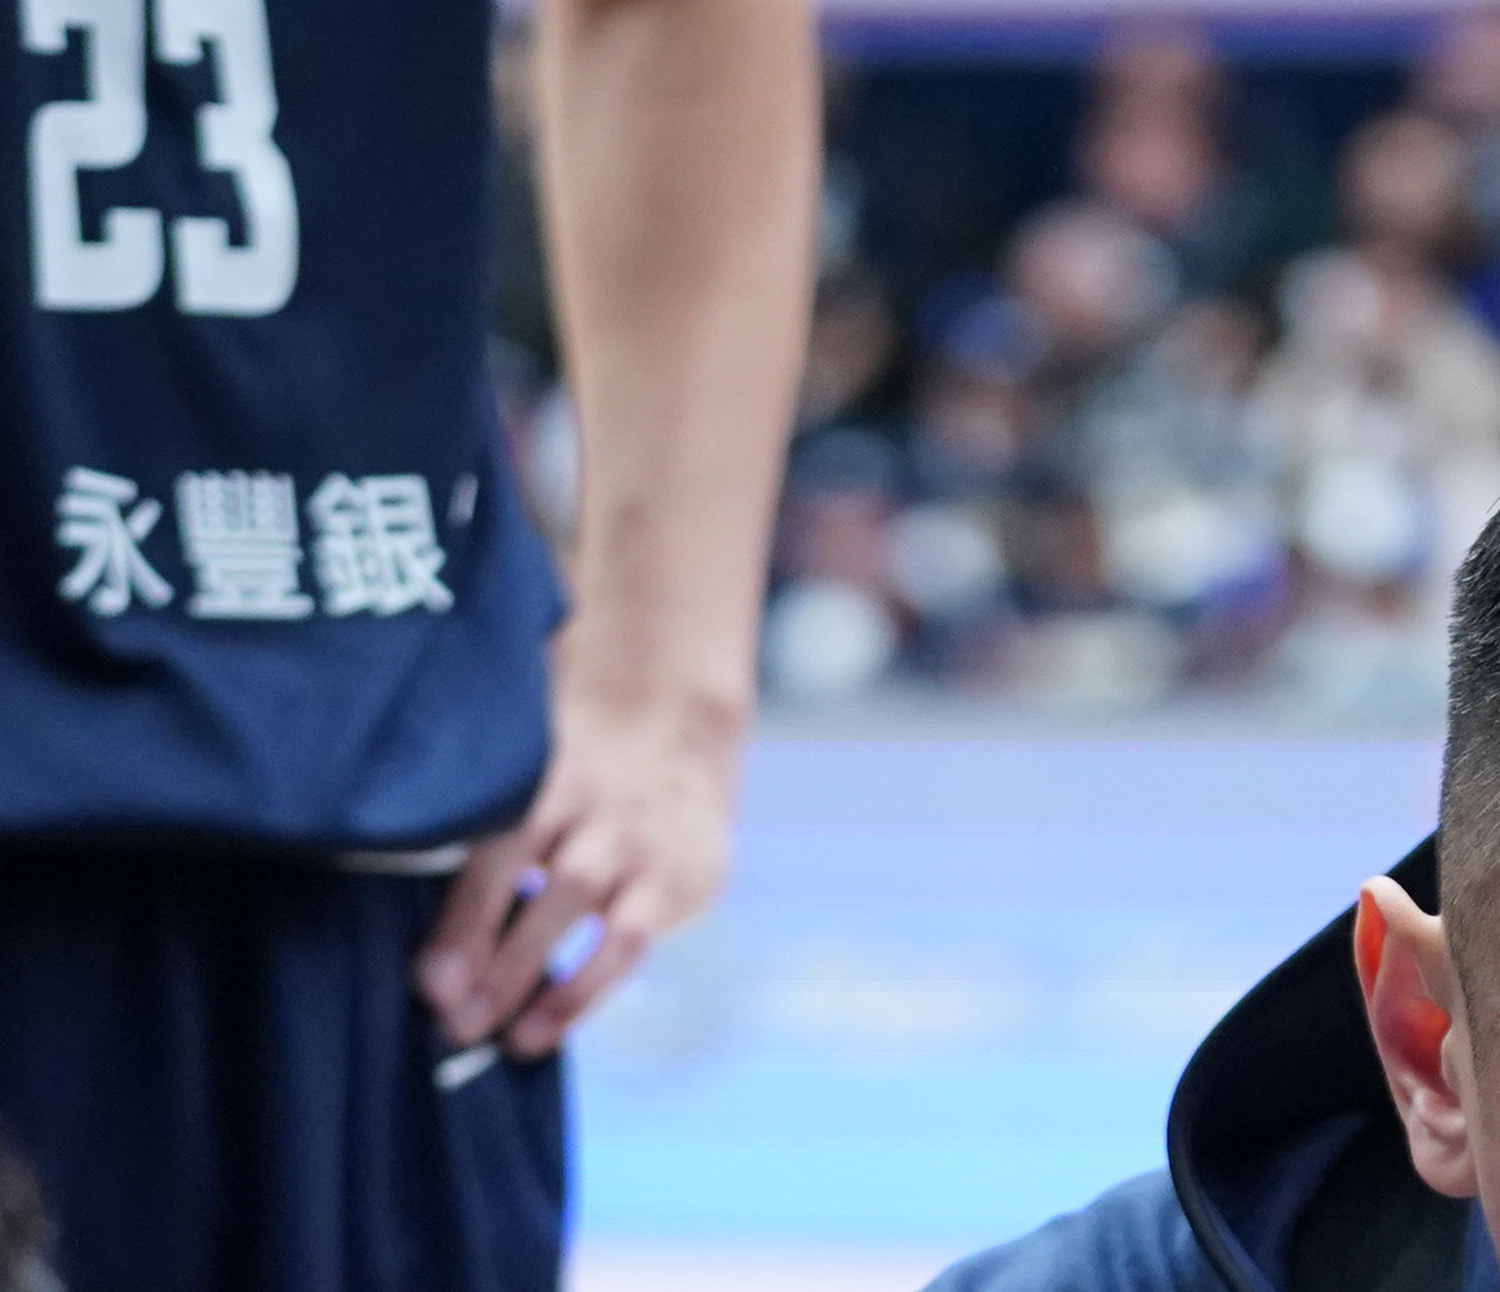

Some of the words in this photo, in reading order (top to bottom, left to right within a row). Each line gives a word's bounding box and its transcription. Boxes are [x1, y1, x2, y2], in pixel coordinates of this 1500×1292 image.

[23, 0, 298, 314] 23
[54, 466, 478, 622] 永豐銀
